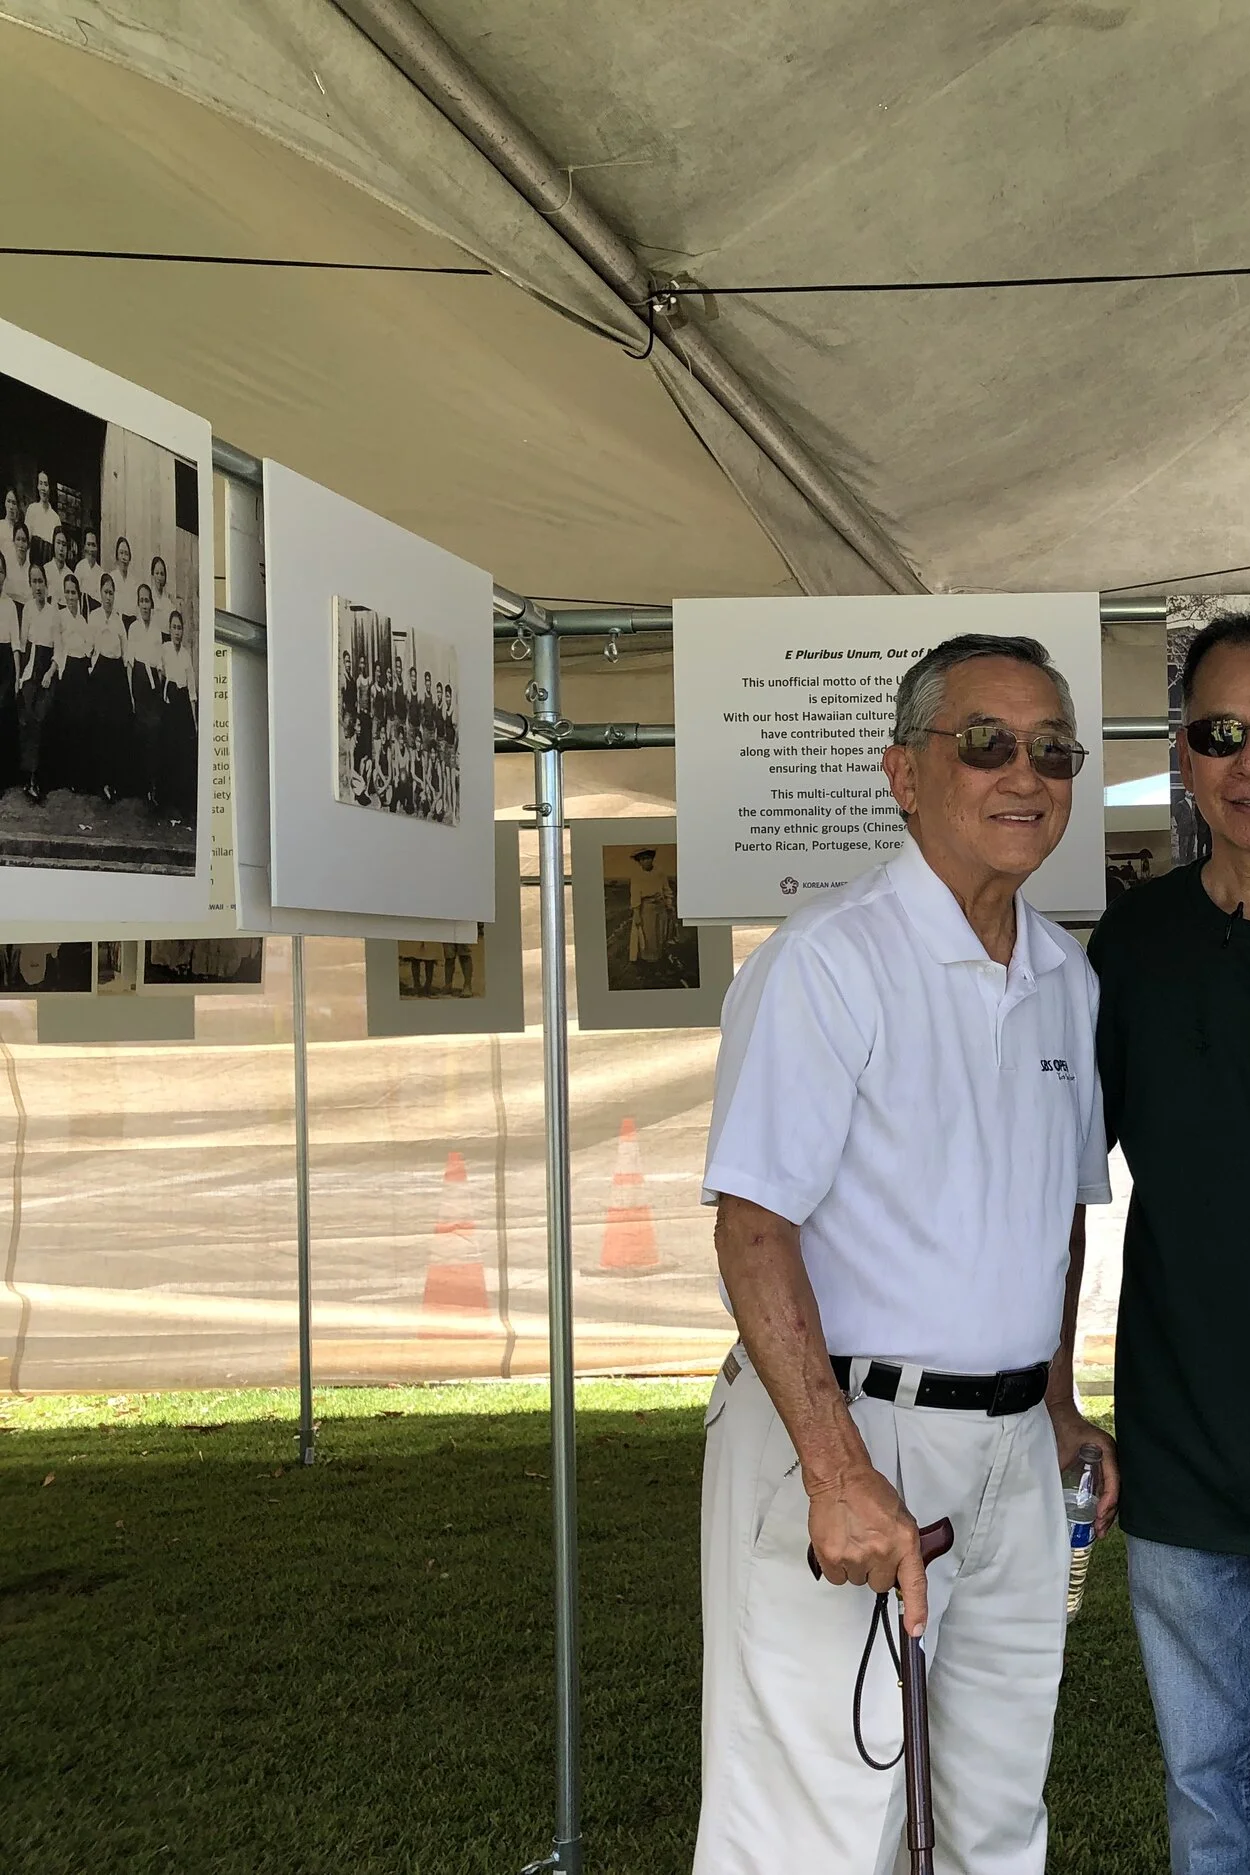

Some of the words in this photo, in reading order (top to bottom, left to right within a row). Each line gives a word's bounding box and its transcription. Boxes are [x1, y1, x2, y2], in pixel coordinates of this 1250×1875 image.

[785, 651, 793, 659] E
[796, 650, 843, 659] Pluribus
[847, 650, 882, 660] Unum,
[887, 649, 908, 658] Out
[911, 648, 925, 658] of
[742, 678, 764, 687] This
[769, 677, 819, 687] unofficial
[823, 677, 856, 686] motto
[860, 676, 871, 685] of
[875, 676, 892, 686] the
[809, 694, 817, 703] is
[821, 693, 882, 705] epitomized
[724, 712, 749, 722] With
[775, 712, 798, 721] host
[803, 711, 852, 721] Hawaiian
[761, 729, 787, 739] have
[791, 728, 855, 738] contributed
[859, 728, 885, 737] their
[214, 748, 230, 756] Vill
[740, 747, 770, 758] along
[774, 746, 797, 756] with
[801, 746, 827, 755] their
[831, 746, 863, 756] hopes
[868, 745, 887, 754] and
[769, 763, 817, 774] ensuring
[820, 763, 842, 772] that
[771, 789, 793, 799] This
[798, 788, 871, 798] multi-cultural
[738, 807, 756, 817] the
[760, 806, 831, 817] commonality
[835, 805, 846, 815] of
[850, 805, 867, 815] the
[872, 804, 901, 814] immi
[751, 826, 780, 835] many
[784, 824, 818, 833] ethnic
[822, 825, 859, 834] groups
[735, 842, 772, 851] Puerto
[776, 841, 808, 852] Rican,
[813, 841, 870, 851] Portugese,
